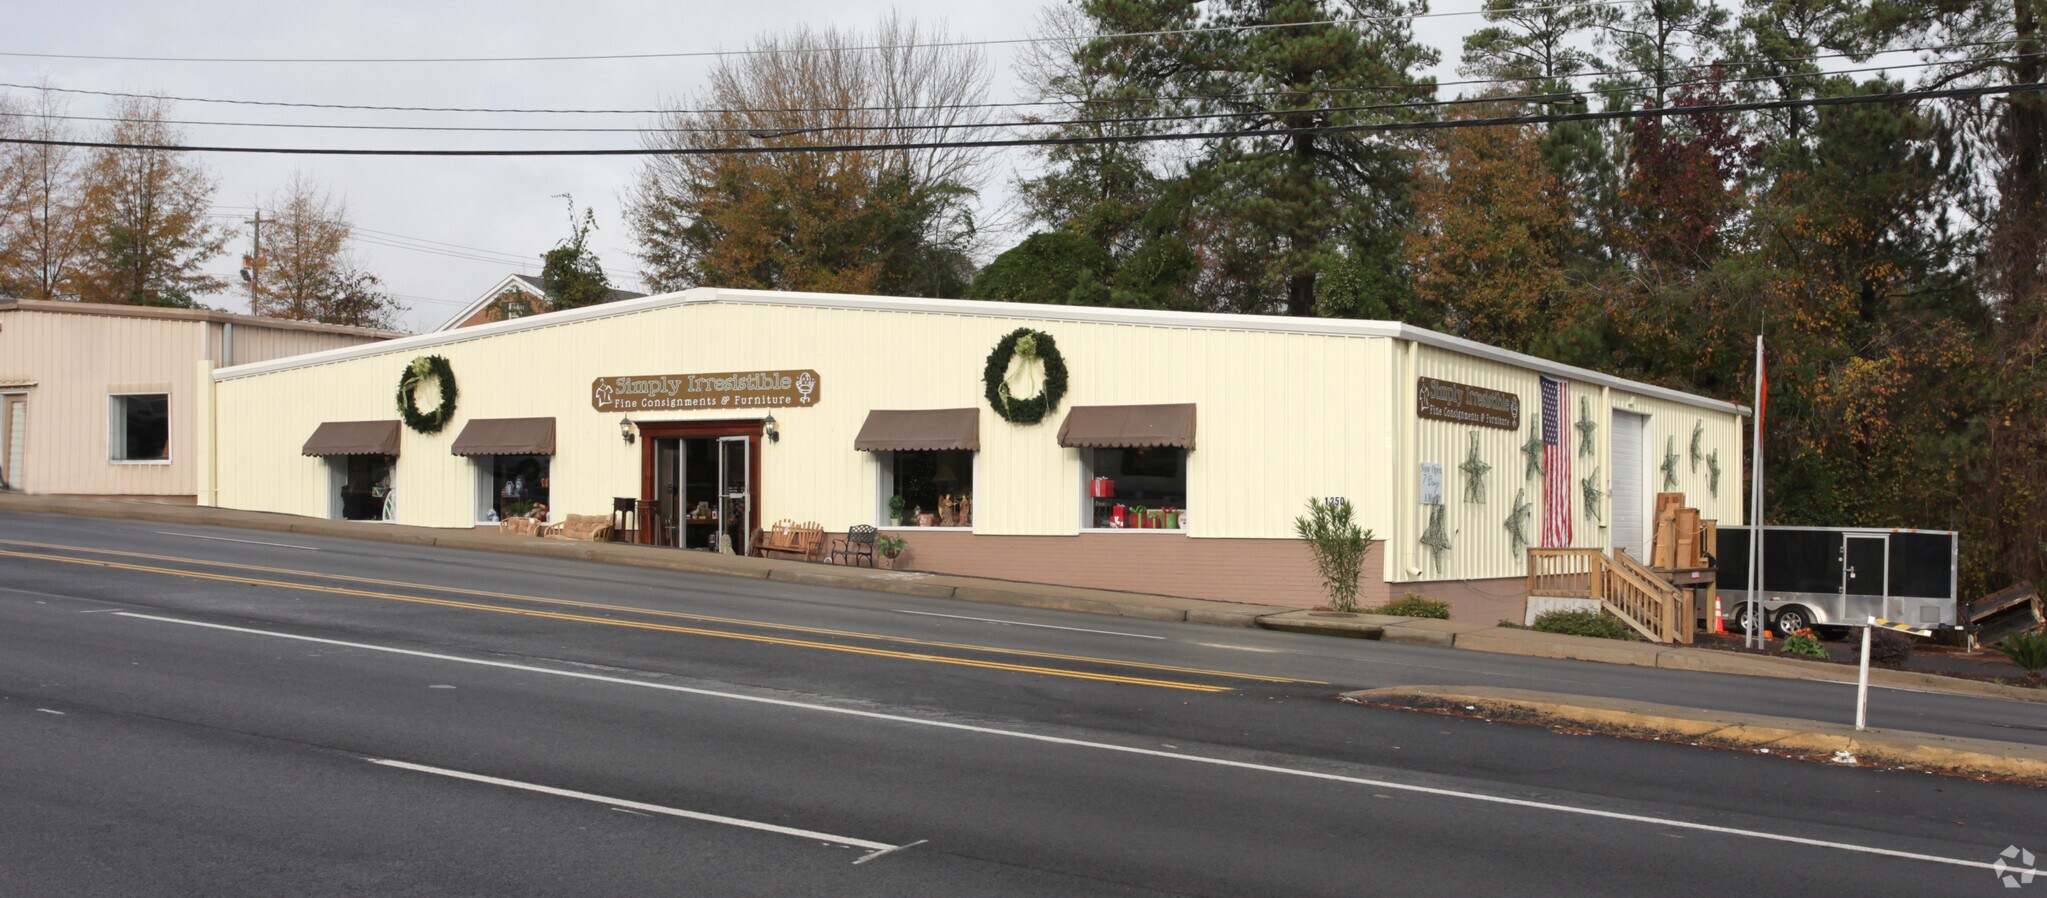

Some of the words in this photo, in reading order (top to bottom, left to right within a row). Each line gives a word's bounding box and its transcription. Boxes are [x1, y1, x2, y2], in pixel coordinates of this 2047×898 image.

[615, 376, 682, 397] Simply
[687, 372, 792, 393] Irresistible
[1430, 380, 1464, 407] Simply
[1465, 386, 1510, 412] Irresistible
[614, 398, 638, 408] Fine
[641, 396, 717, 408] Consignments
[720, 395, 731, 405] &
[734, 394, 792, 405] Furniture
[1429, 404, 1442, 416] Fine
[1443, 406, 1479, 422] Consignments
[1486, 413, 1510, 427] Furniture
[1324, 496, 1345, 506] 1250
